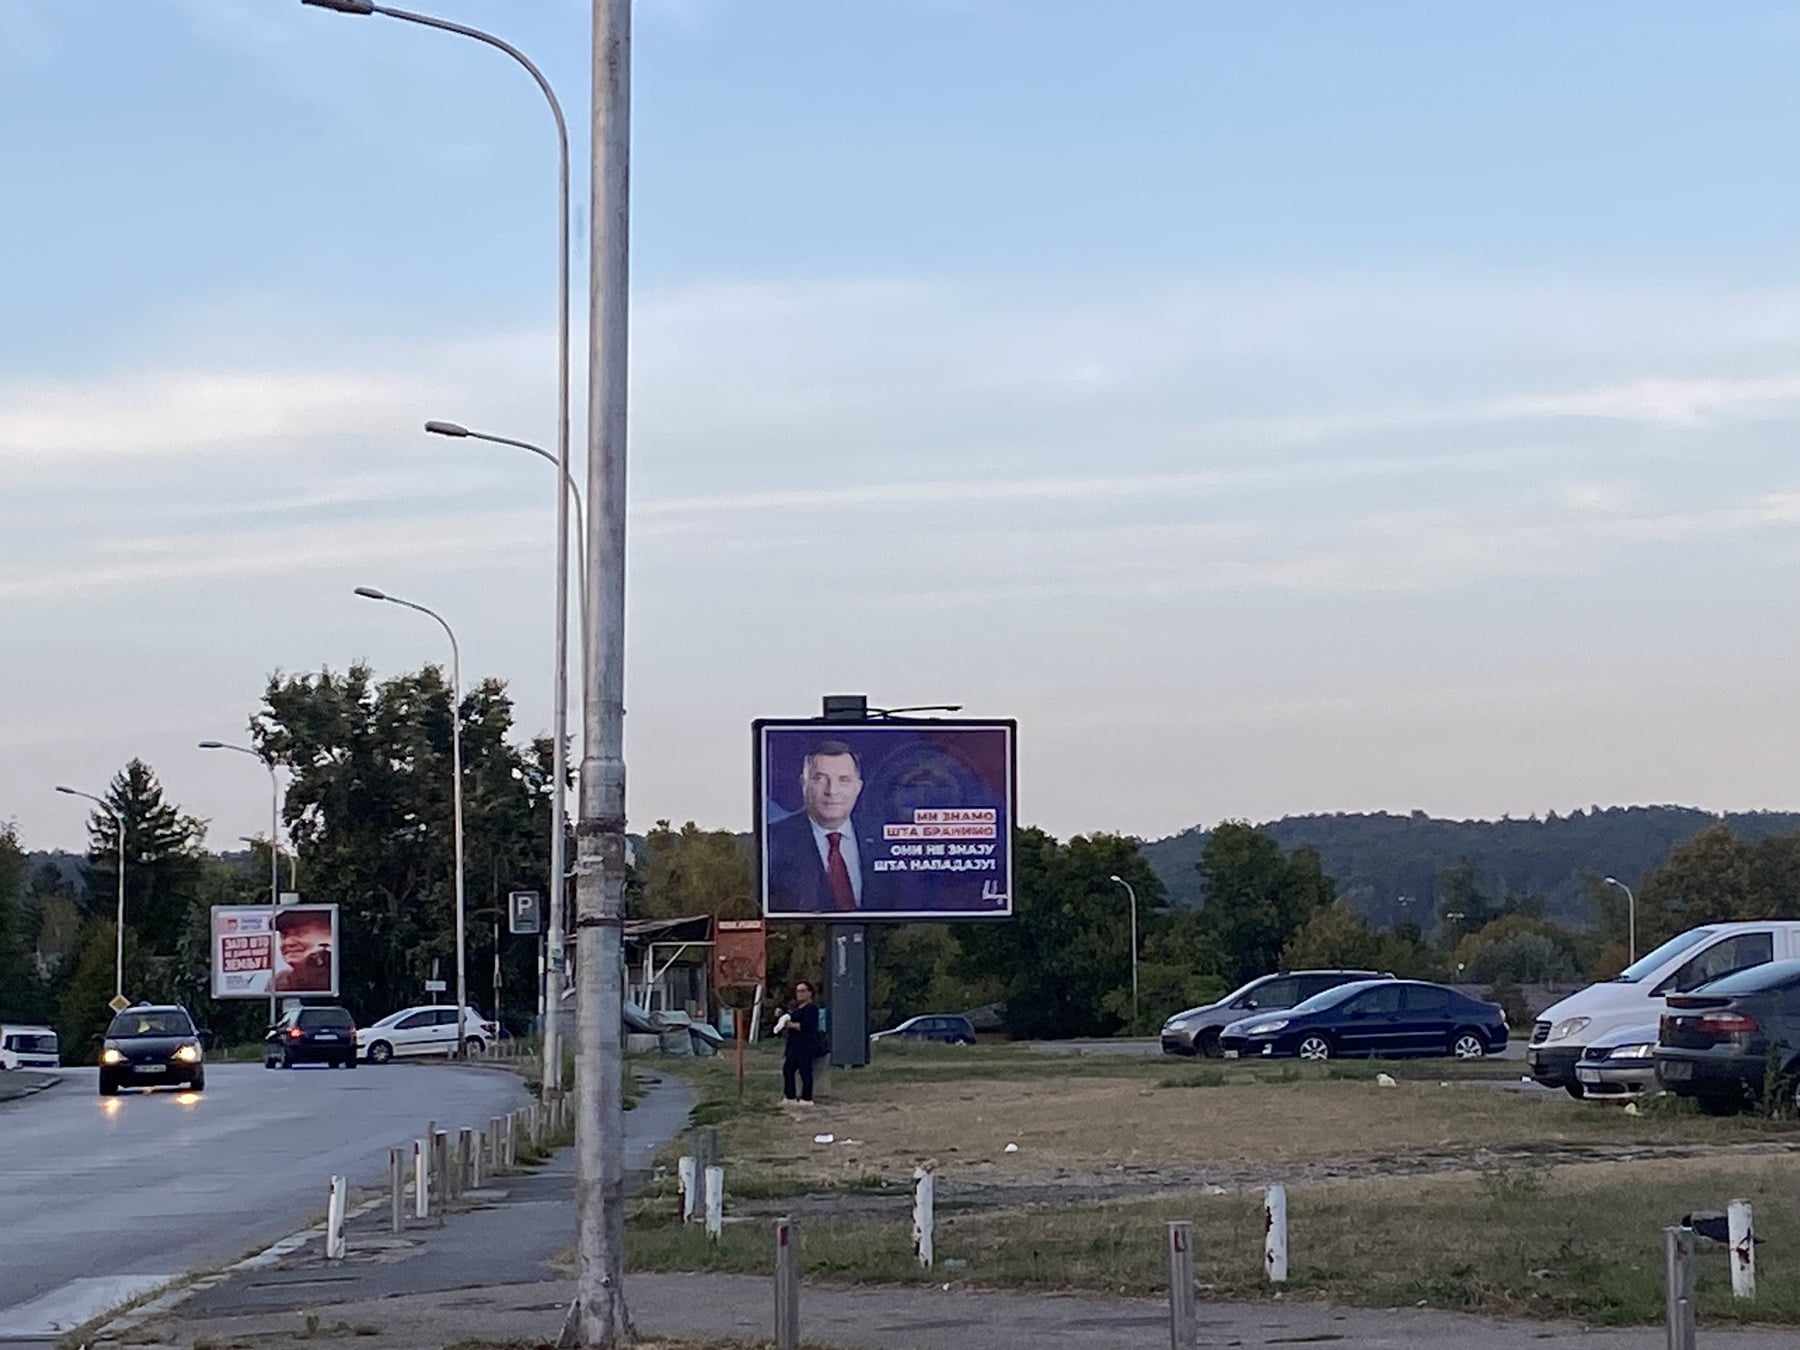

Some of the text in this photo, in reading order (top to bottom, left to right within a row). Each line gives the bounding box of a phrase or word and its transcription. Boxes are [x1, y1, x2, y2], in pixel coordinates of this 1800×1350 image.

[917, 811, 994, 822] МИ ЗНАМО
[886, 827, 919, 837] ШТА
[890, 843, 995, 856] ОНИ НЕ ЗНАЈУ
[874, 859, 908, 872] ШТА
[518, 896, 533, 916] P
